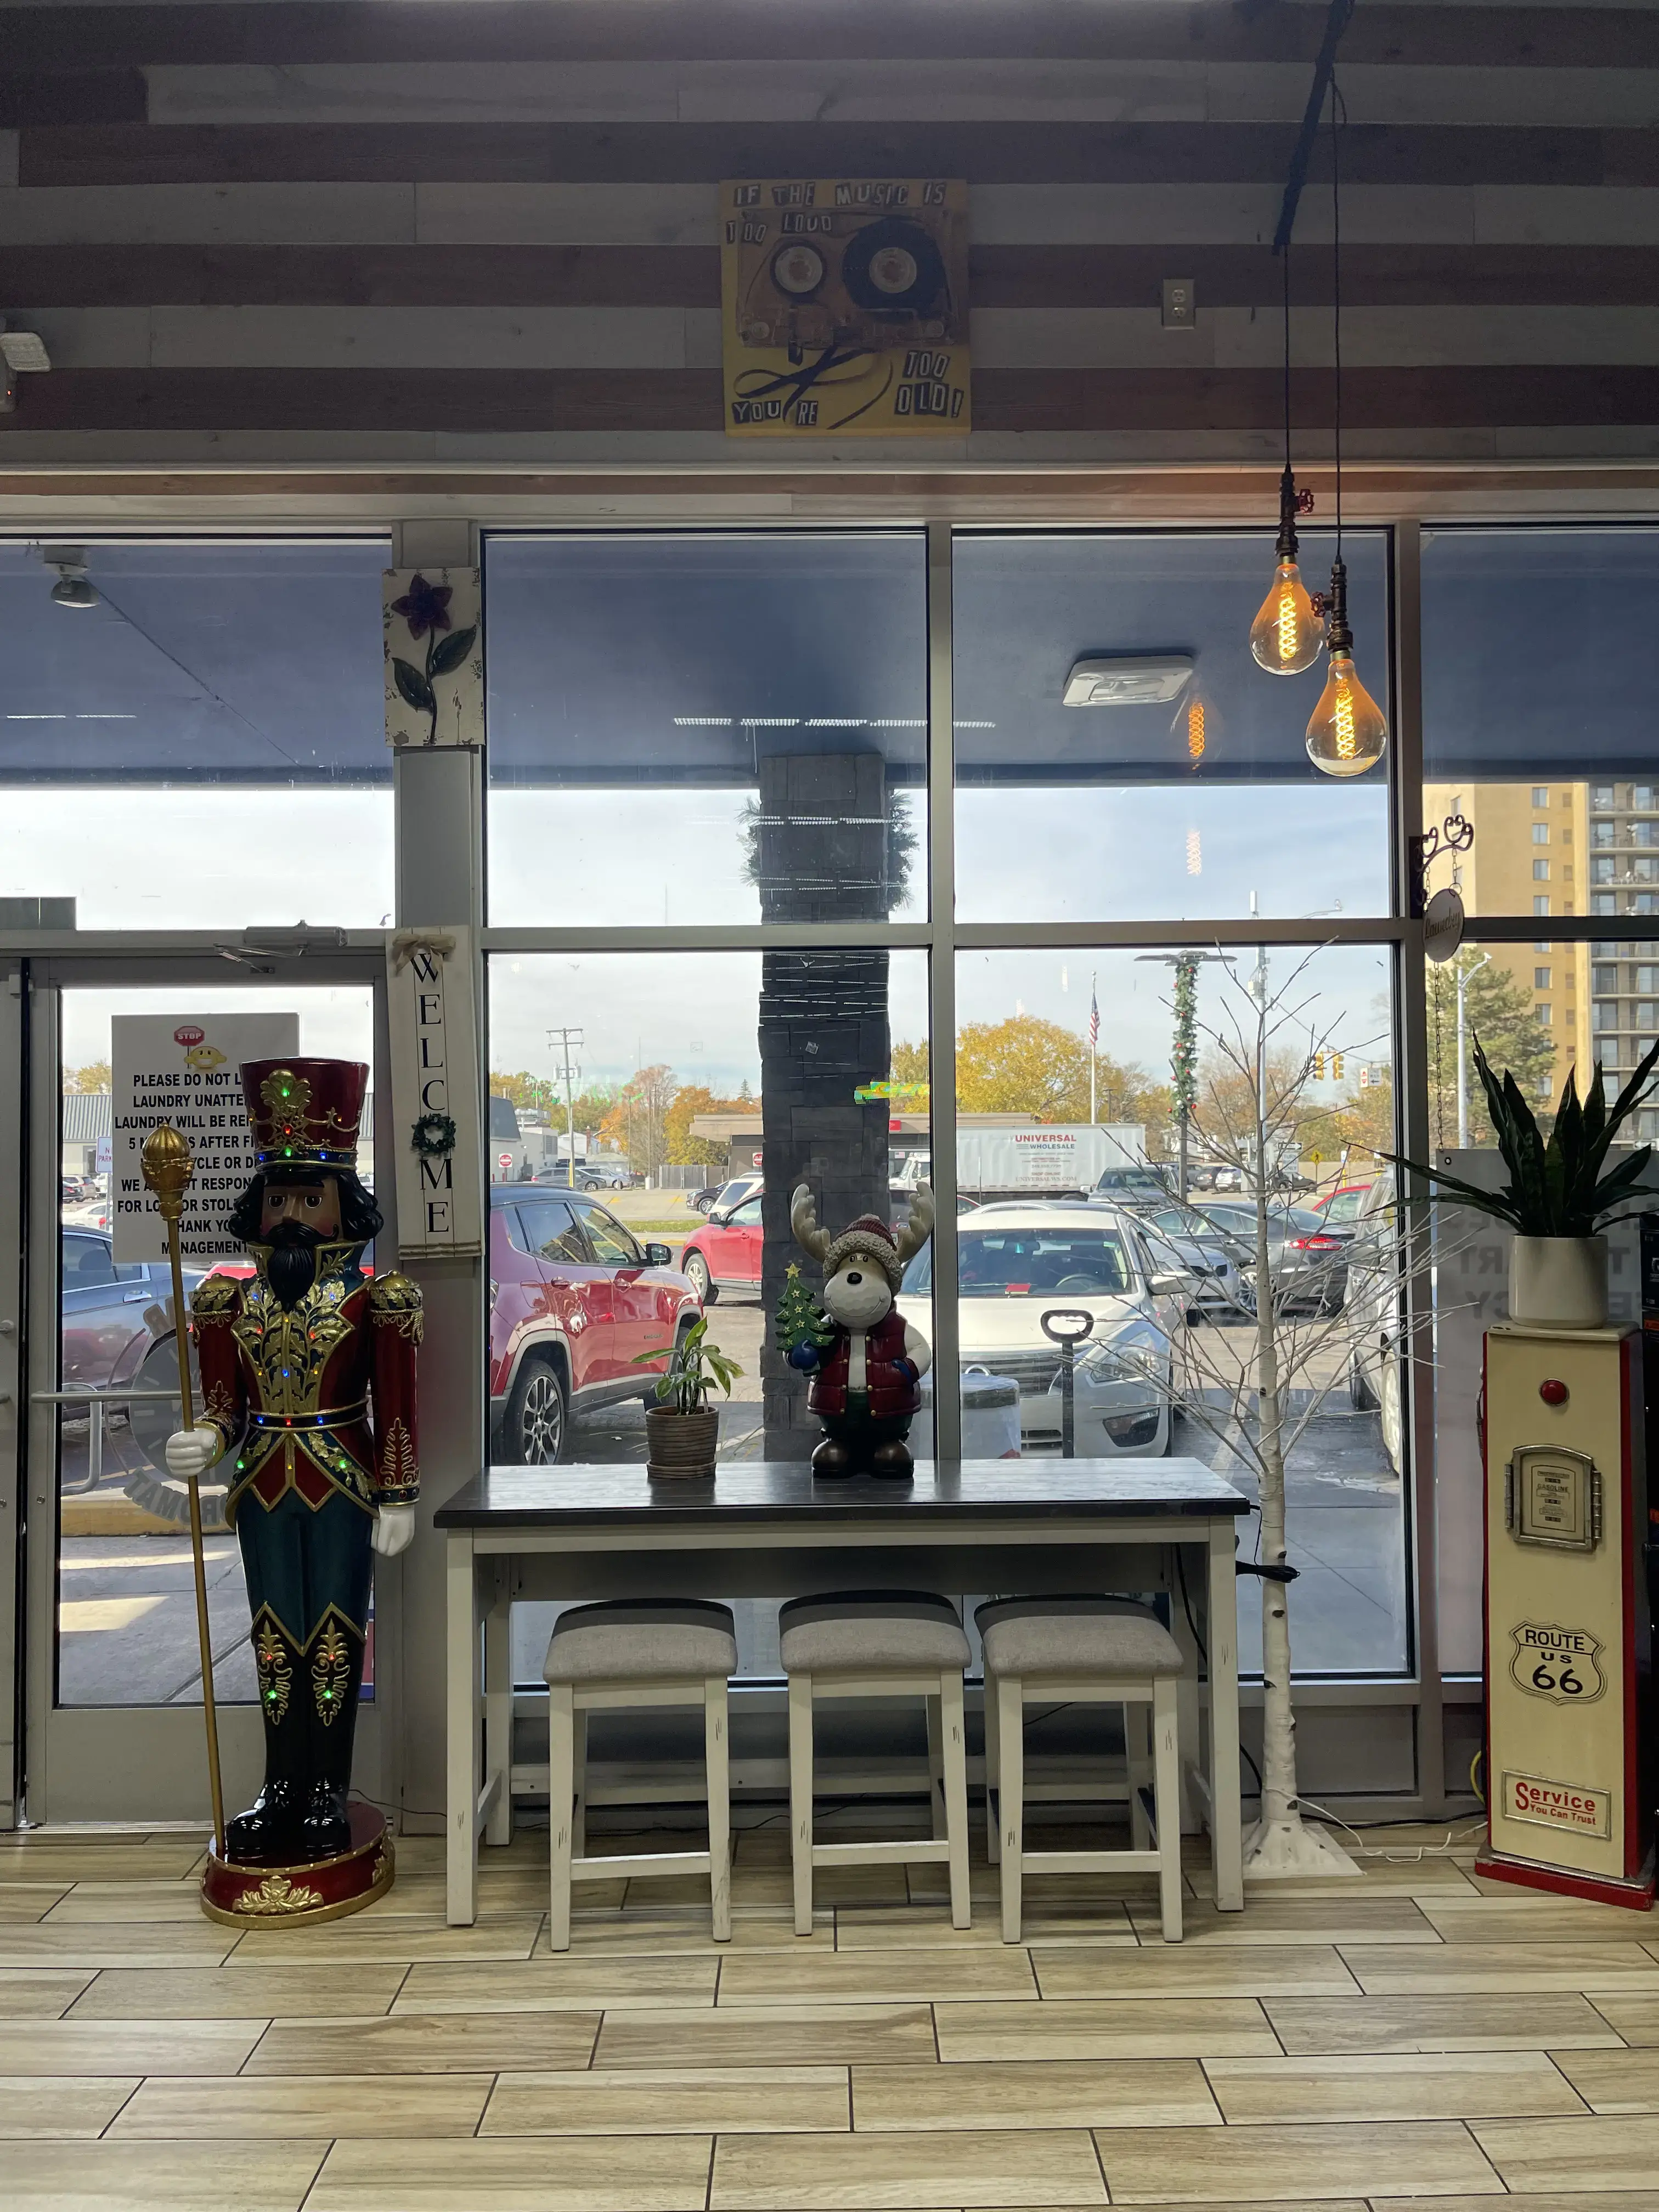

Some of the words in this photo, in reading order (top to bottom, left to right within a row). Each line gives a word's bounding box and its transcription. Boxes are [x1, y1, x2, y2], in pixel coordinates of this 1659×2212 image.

[736, 185, 760, 205] IF
[774, 183, 815, 206] THE
[836, 184, 909, 205] MUSIC
[923, 183, 945, 205] IS
[726, 221, 767, 242] TOO
[783, 213, 832, 232] LOUD
[908, 351, 948, 378] TOO
[1424, 906, 1462, 941] Laundry
[133, 1074, 180, 1087] PLEASE
[184, 1073, 201, 1086] DO
[205, 1073, 230, 1086] NOT
[133, 1094, 191, 1108] LAUNDRY
[195, 1093, 246, 1107] UNATTE
[115, 1116, 172, 1129] LAUNDRY
[176, 1115, 206, 1128] WILL
[210, 1115, 225, 1127] BE
[129, 1137, 136, 1150] 5
[199, 1136, 239, 1149] AFTER
[1015, 1134, 1076, 1142] UNIVERSAL
[224, 1156, 242, 1169] OR
[121, 1179, 139, 1192] WE
[117, 1200, 142, 1212] FOR
[183, 1199, 198, 1211] OR
[178, 1220, 211, 1233] HANK
[161, 1240, 247, 1254] MNAGEMENT
[1537, 1483, 1569, 1493] GASOLINE
[1525, 1629, 1585, 1651] ROUTE
[1532, 1664, 1583, 1695] 66
[1515, 1782, 1596, 1812] Service
[1530, 1803, 1547, 1815] You
[1550, 1808, 1568, 1819] Can
[1571, 1812, 1596, 1826] Trust
